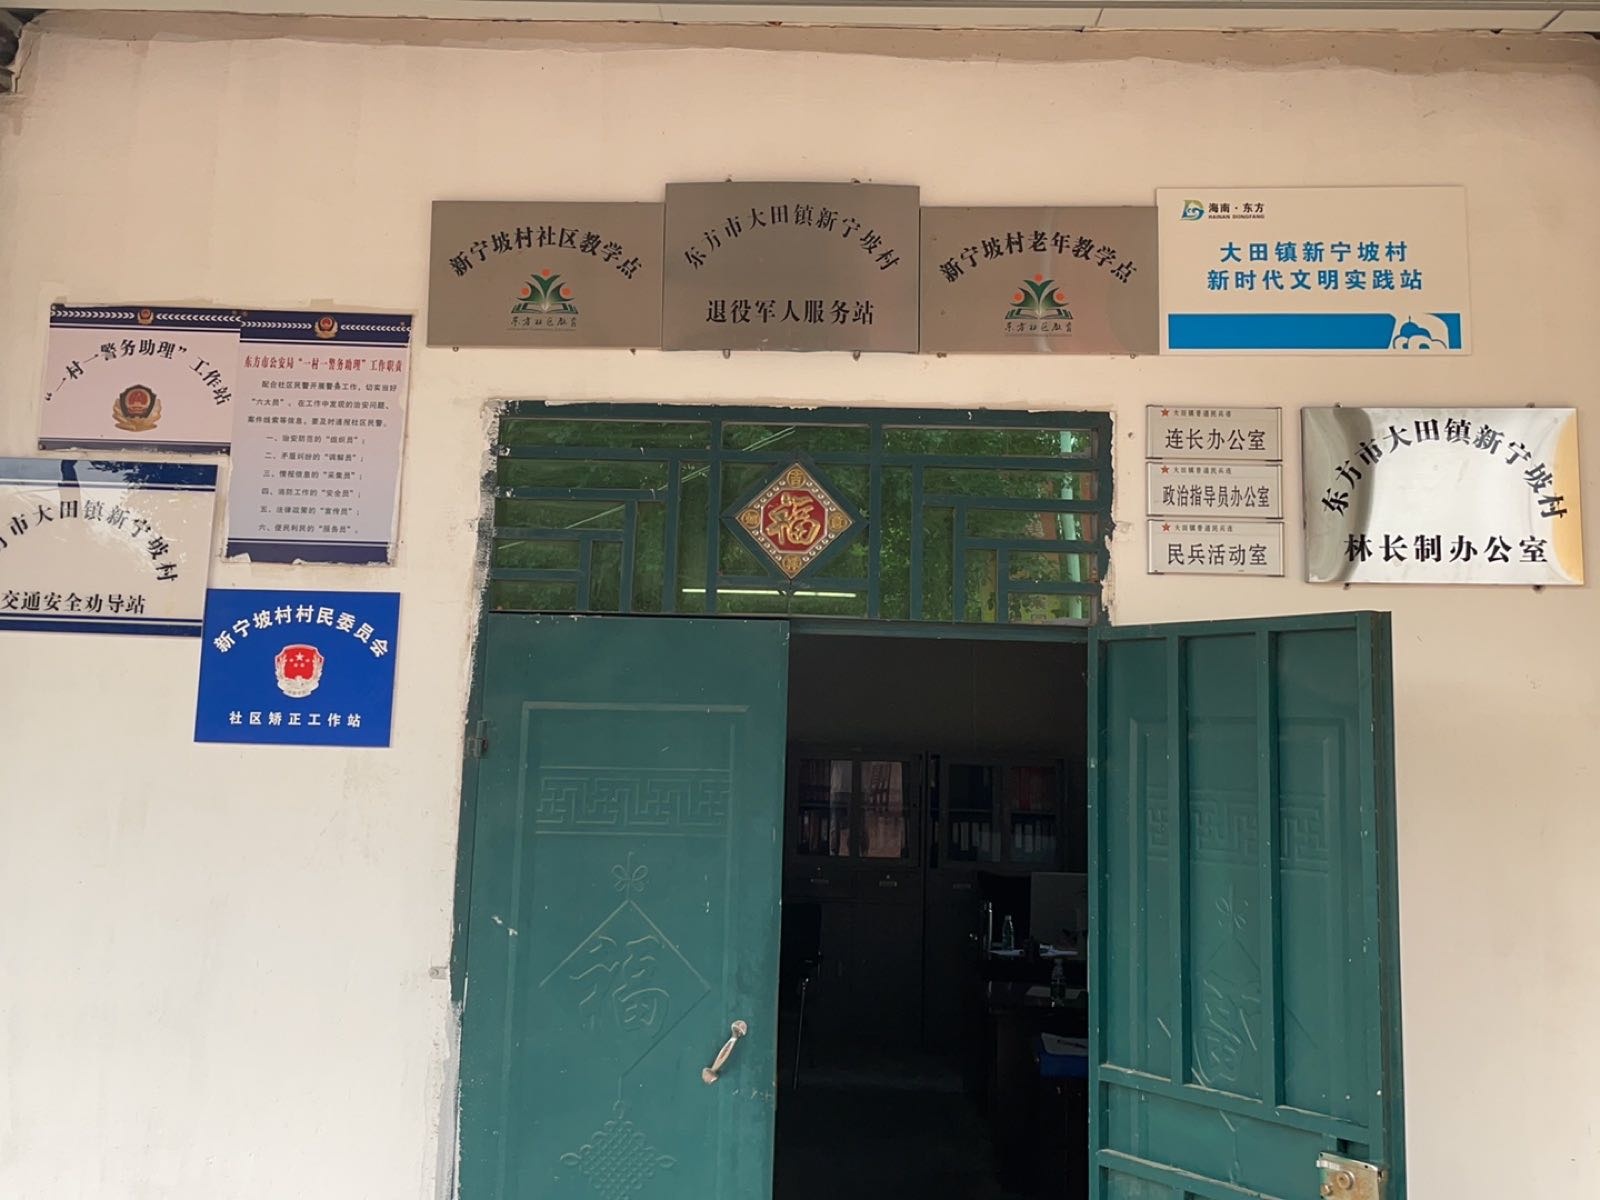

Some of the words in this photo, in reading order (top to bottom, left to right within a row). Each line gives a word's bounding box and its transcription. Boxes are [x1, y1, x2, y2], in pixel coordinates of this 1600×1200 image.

[685, 204, 900, 270] 东方市大田镇新宁坡村
[449, 225, 642, 280] 新宁坡村社区教学点
[939, 230, 1137, 283] 新宁坡村老年教学点
[1220, 241, 1407, 263] 大田镇新宁坡村
[1207, 269, 1422, 291] 新时代文明实践站
[705, 299, 874, 325] 退役军人服务站
[1165, 428, 1266, 451] 连长办公室
[1321, 417, 1568, 519] 东方市大田镇新宁坡村
[1162, 485, 1270, 508] 政治指导员办公室
[1168, 543, 1268, 566] 民兵活动室
[1344, 533, 1548, 563] 林长制办公室
[1, 590, 146, 614] 交通安全劝导站
[213, 604, 389, 658] 新宁坡村村民委员会
[229, 711, 362, 727] 社区矫正工作站
